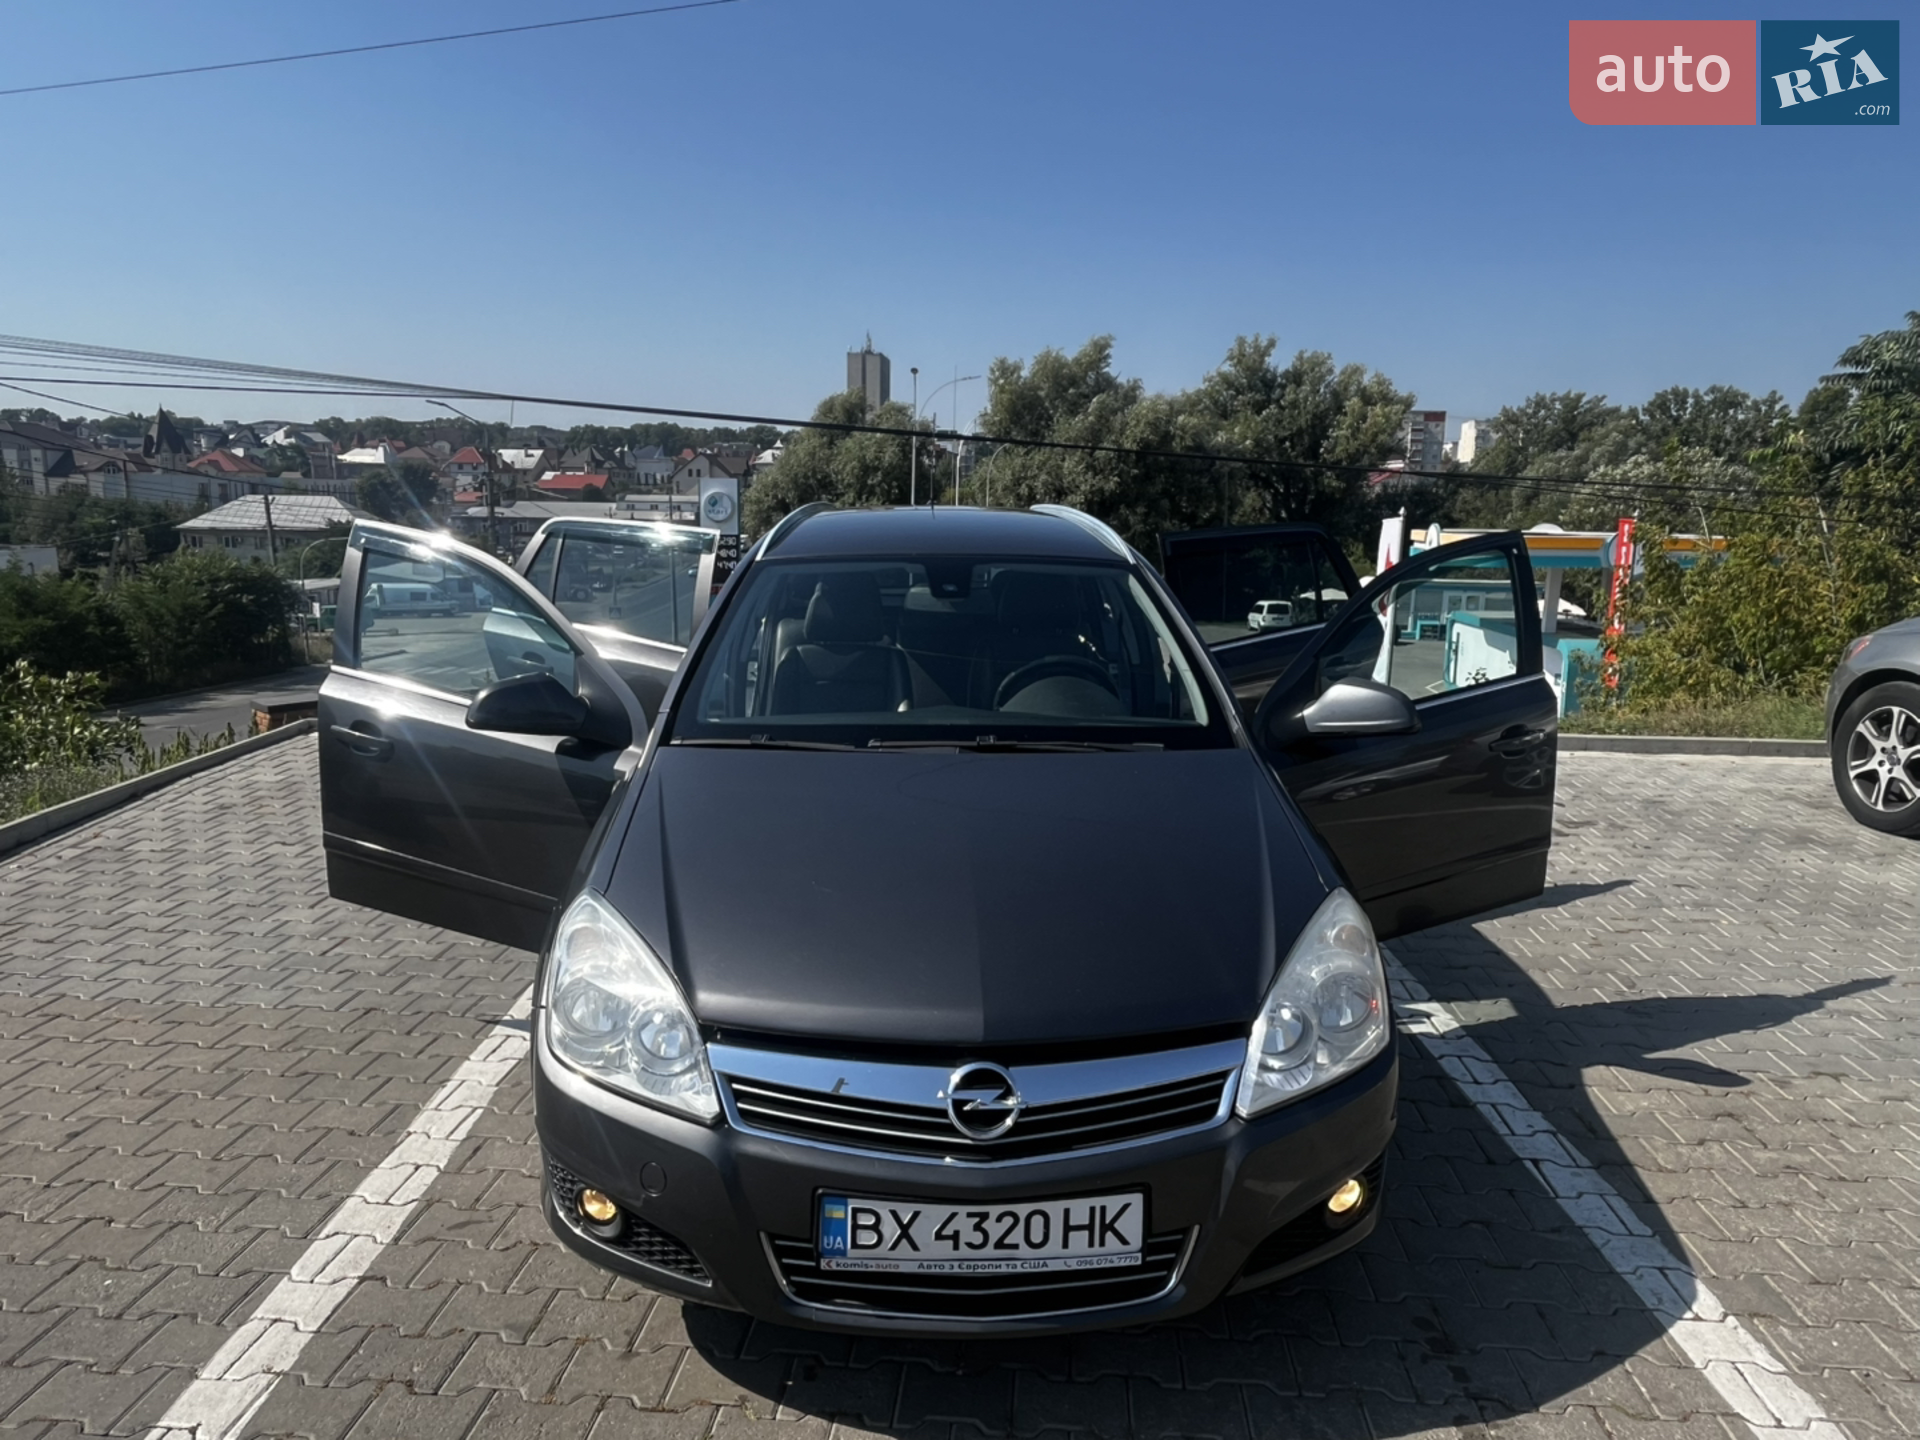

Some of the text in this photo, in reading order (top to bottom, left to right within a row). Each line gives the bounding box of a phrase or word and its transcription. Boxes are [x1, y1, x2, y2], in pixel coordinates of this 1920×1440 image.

[850, 1202, 1133, 1252] BX 4320 HK
[823, 1236, 845, 1250] UA
[917, 1262, 945, 1271] Авто
[958, 1261, 1002, 1272] Європи
[1020, 1261, 1049, 1270] США
